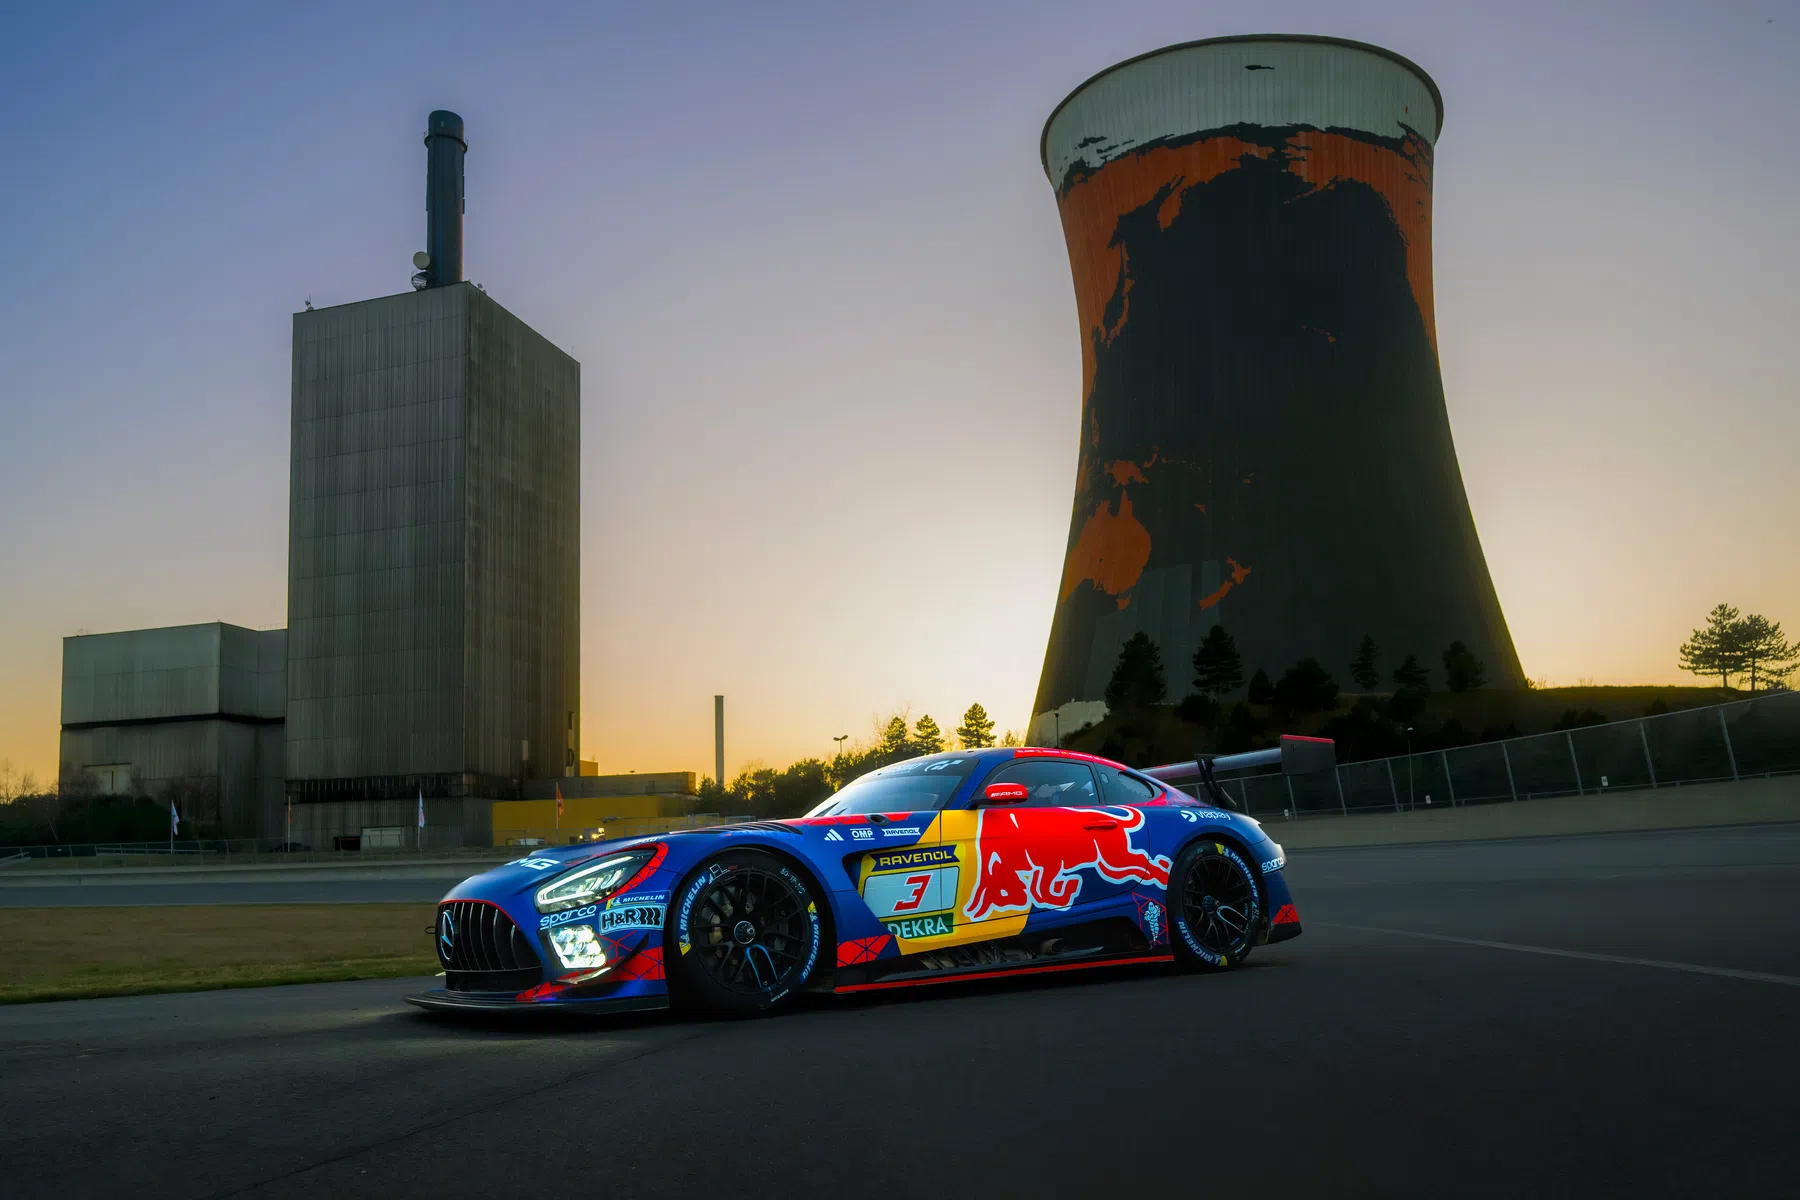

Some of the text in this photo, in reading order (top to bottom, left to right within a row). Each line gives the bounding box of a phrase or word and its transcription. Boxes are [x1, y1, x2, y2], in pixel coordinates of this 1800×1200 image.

[851, 830, 873, 839] OMP
[1230, 853, 1258, 897] MICHELIN
[623, 894, 665, 903] MICHELIN
[680, 875, 706, 931] MICHELIN
[892, 873, 932, 912] 3
[540, 905, 597, 928] sparco
[602, 908, 638, 930] H&R
[888, 916, 949, 939] DEKRA
[802, 924, 819, 979] MICHELIN
[1178, 921, 1213, 962] MICHELIN
